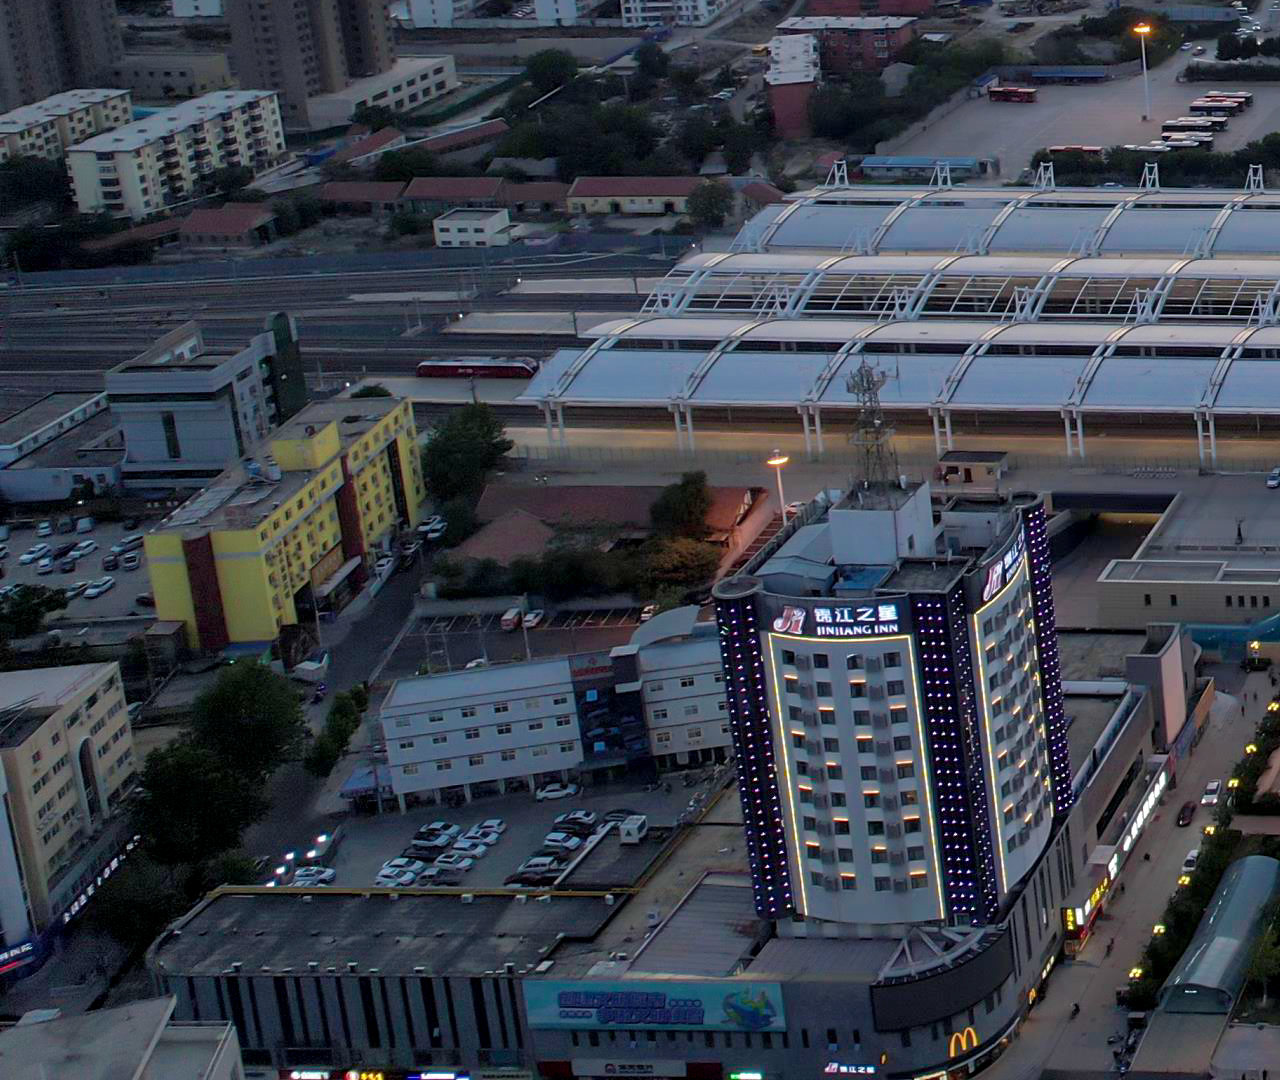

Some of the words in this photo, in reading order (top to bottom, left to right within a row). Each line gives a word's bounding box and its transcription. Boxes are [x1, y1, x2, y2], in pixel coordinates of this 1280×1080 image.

[814, 604, 899, 623] 锦江之星
[816, 624, 872, 636] JINJIANG
[874, 623, 899, 634] INN
